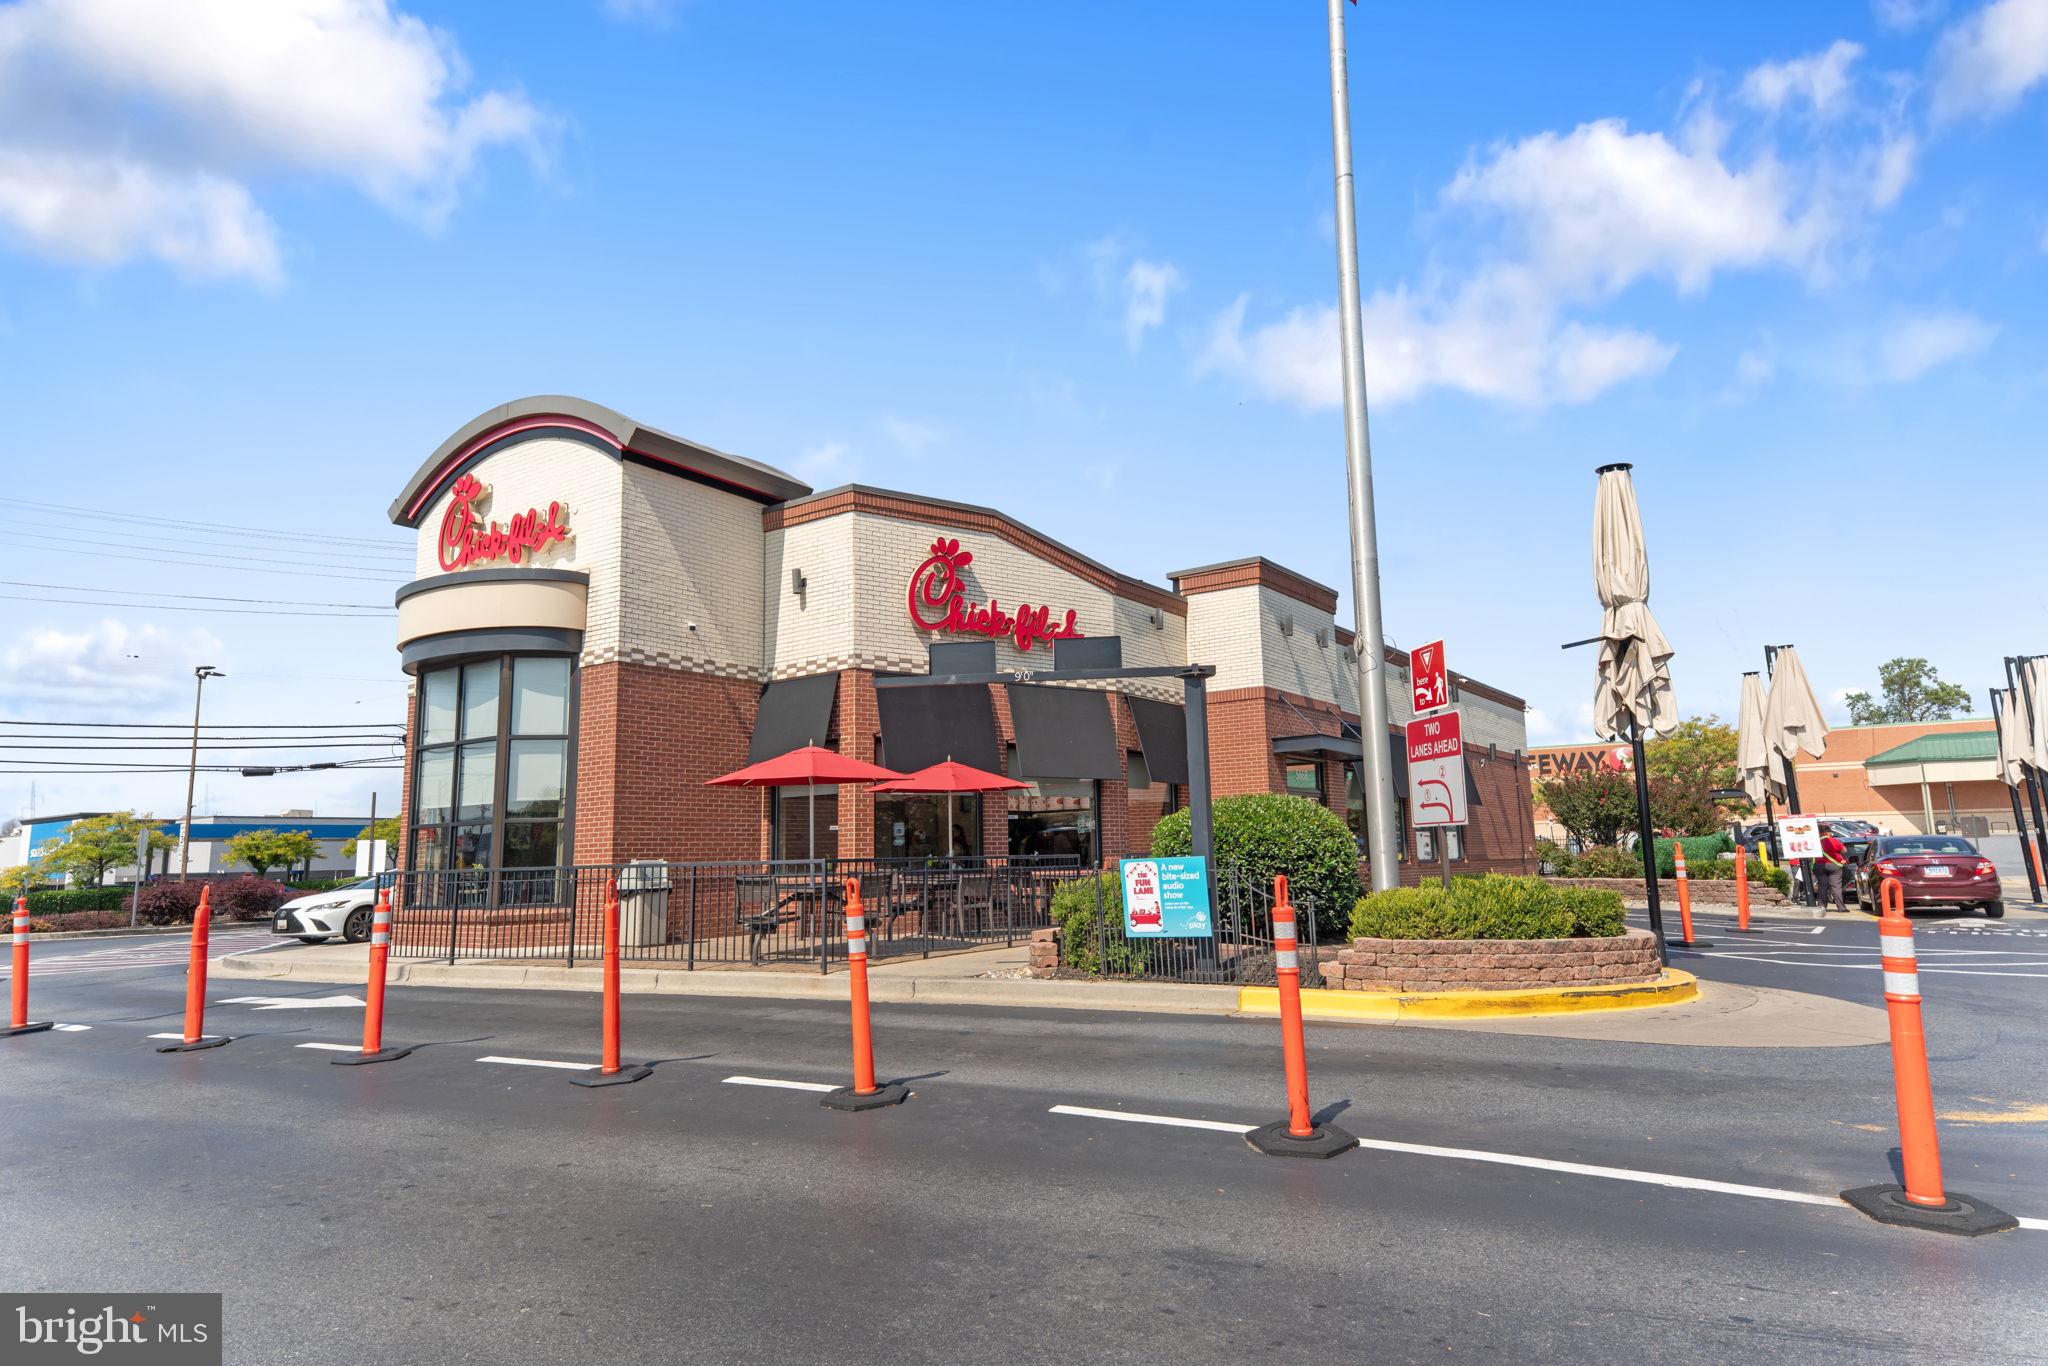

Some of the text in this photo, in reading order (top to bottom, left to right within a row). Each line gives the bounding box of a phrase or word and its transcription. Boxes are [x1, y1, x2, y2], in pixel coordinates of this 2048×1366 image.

[1416, 676, 1429, 686] here
[1419, 698, 1426, 706] to
[1424, 722, 1441, 737] TWO
[1410, 737, 1459, 758] LANES AHEAD
[1162, 872, 1199, 881] bite-sized
[1135, 879, 1151, 887] FUN
[1163, 882, 1184, 890] audio
[1133, 887, 1154, 895] LANE
[1163, 891, 1184, 899] show
